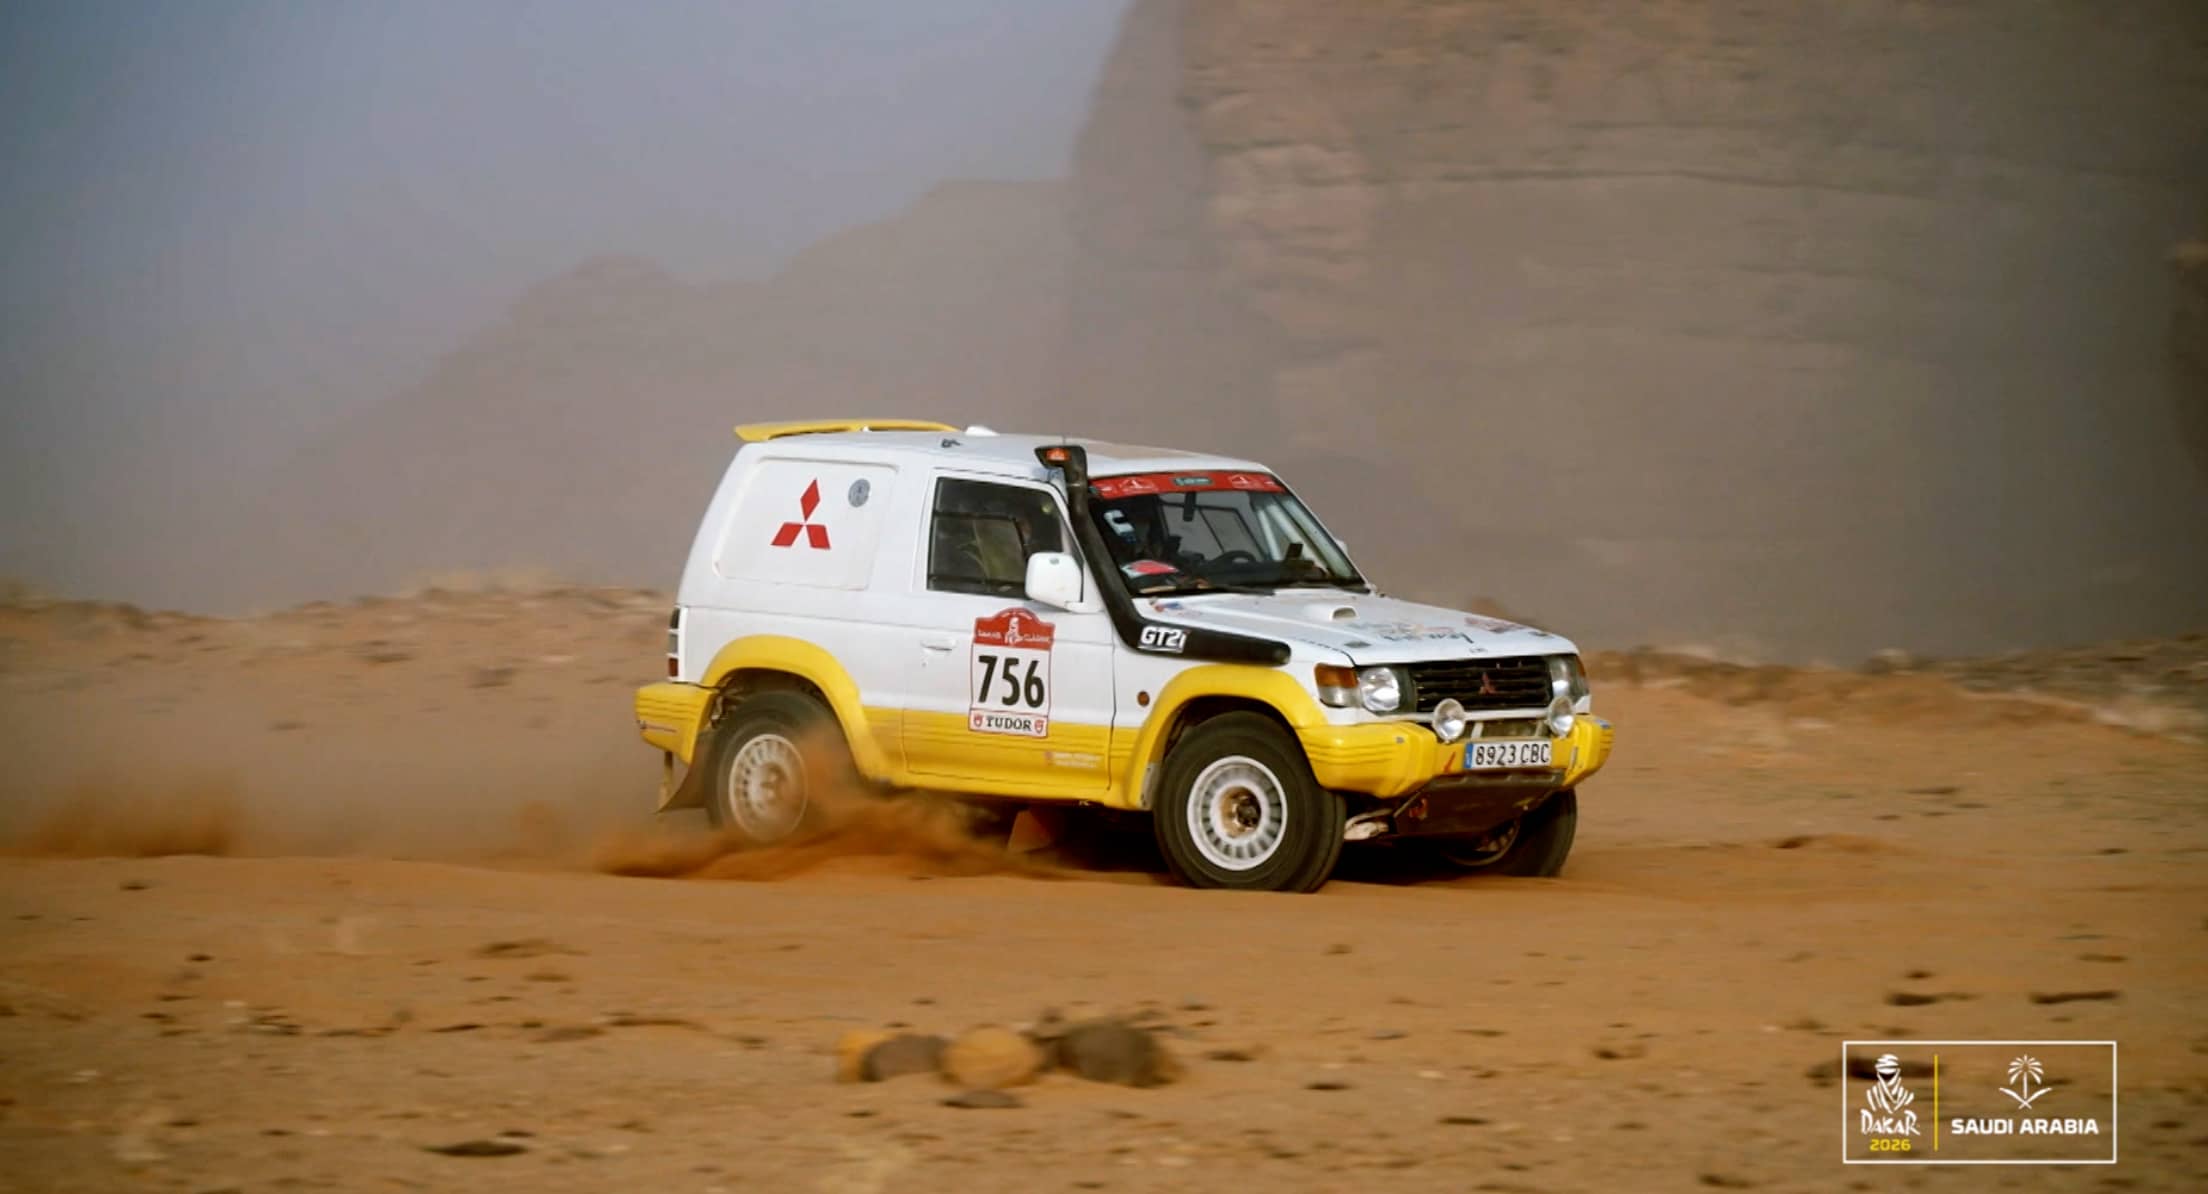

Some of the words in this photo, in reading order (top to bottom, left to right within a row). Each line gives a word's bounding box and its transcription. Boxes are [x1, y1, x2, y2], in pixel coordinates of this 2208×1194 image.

[978, 655, 1045, 708] 756
[986, 716, 1032, 731] TUDOR
[1475, 744, 1516, 766] 8923
[1520, 743, 1549, 763] CBC
